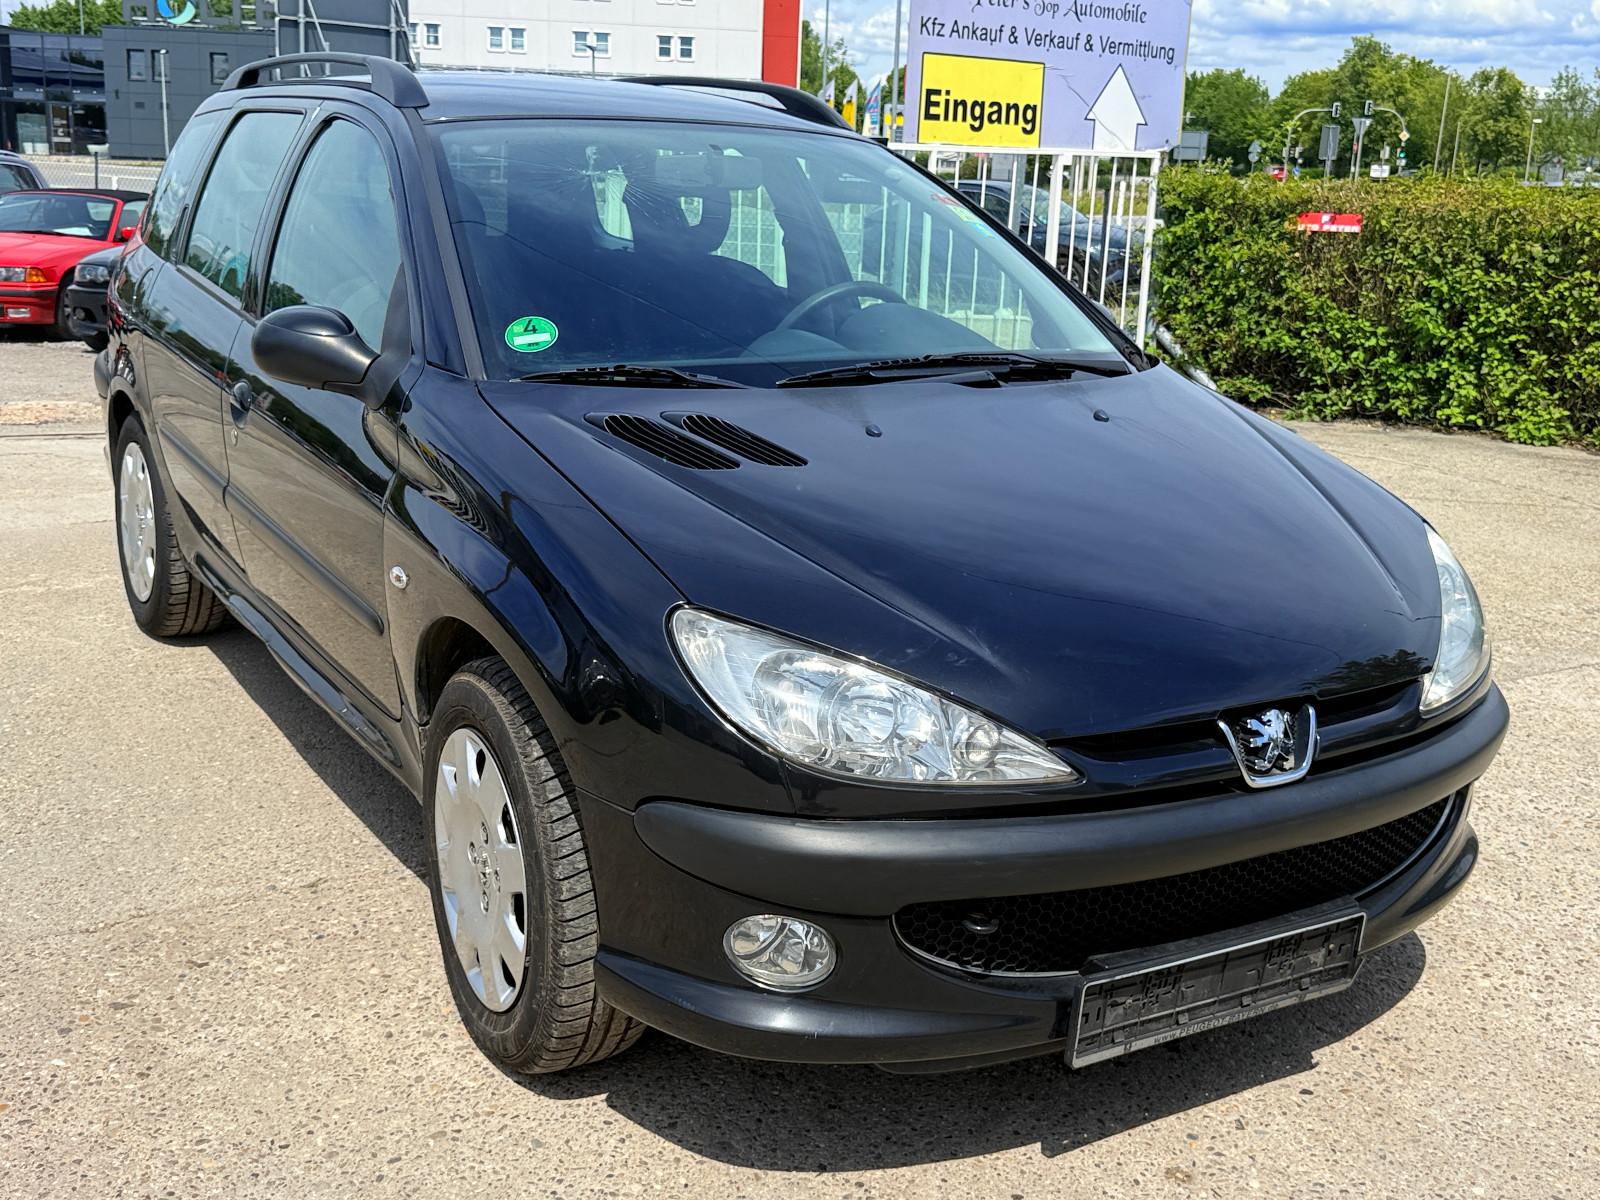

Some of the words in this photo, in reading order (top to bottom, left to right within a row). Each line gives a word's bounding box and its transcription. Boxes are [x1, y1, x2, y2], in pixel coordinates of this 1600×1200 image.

[1063, 0, 1147, 24] Automobile
[920, 16, 945, 38] Kfz
[950, 20, 1004, 44] Ankauf
[1008, 28, 1018, 45] &
[1024, 27, 1081, 51] Verkauf
[1084, 36, 1094, 52] &
[1100, 36, 1175, 64] Vermittlung
[924, 88, 1038, 135] Eingang
[523, 319, 538, 334] 4
